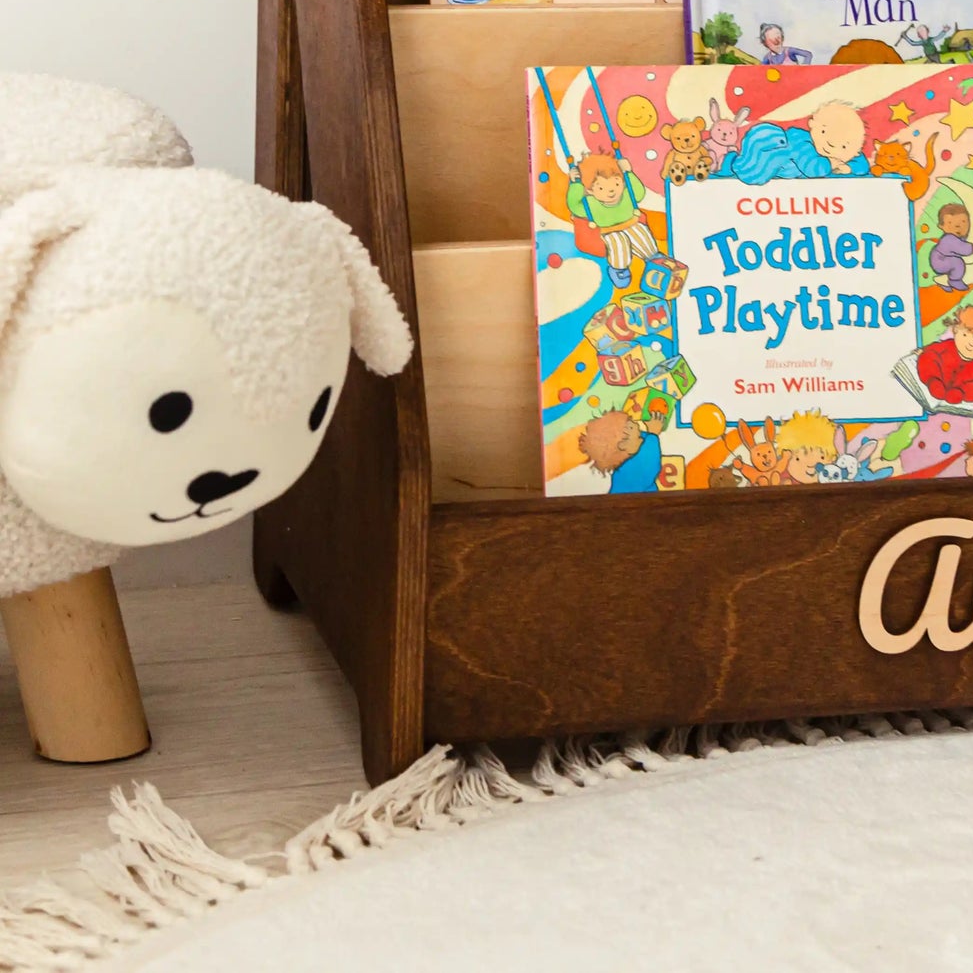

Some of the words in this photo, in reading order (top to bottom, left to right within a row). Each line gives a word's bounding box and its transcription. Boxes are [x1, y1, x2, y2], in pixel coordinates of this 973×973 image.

[736, 196, 845, 216] COLLINS
[703, 225, 884, 277] Toddler
[689, 285, 906, 350] Playtime
[765, 357, 817, 369] Illustrated
[820, 357, 834, 370] by
[733, 378, 776, 395] Sam
[781, 376, 865, 393] Williams
